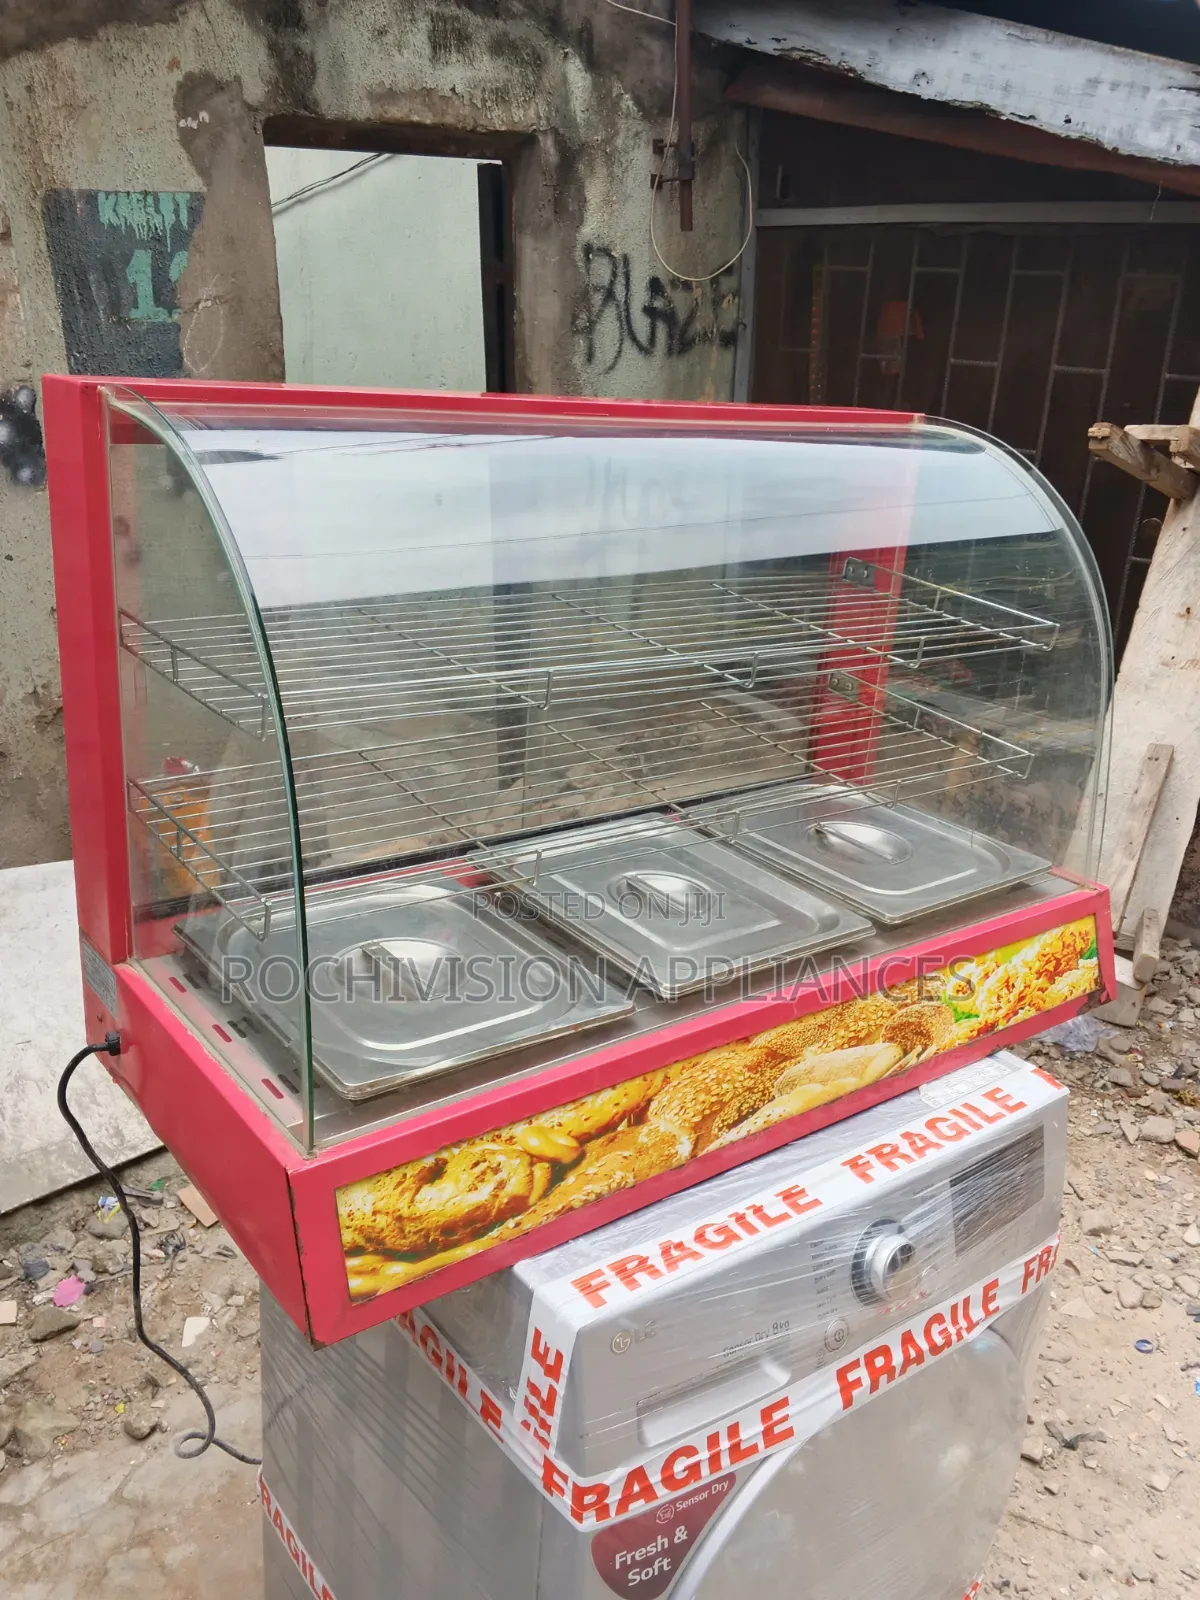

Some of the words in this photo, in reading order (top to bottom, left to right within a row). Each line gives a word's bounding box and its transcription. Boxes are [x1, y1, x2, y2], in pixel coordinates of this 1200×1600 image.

[841, 1087, 1028, 1184] FRAGILE
[570, 1184, 823, 1309] FRAGILE
[835, 1279, 999, 1411] FRAGILE
[541, 1396, 795, 1524] FRAGILE
[676, 1489, 710, 1512] Sensor
[711, 1480, 729, 1497] Dry
[614, 1534, 669, 1570] Fresh
[673, 1525, 688, 1544] &
[627, 1556, 672, 1587] Soft
